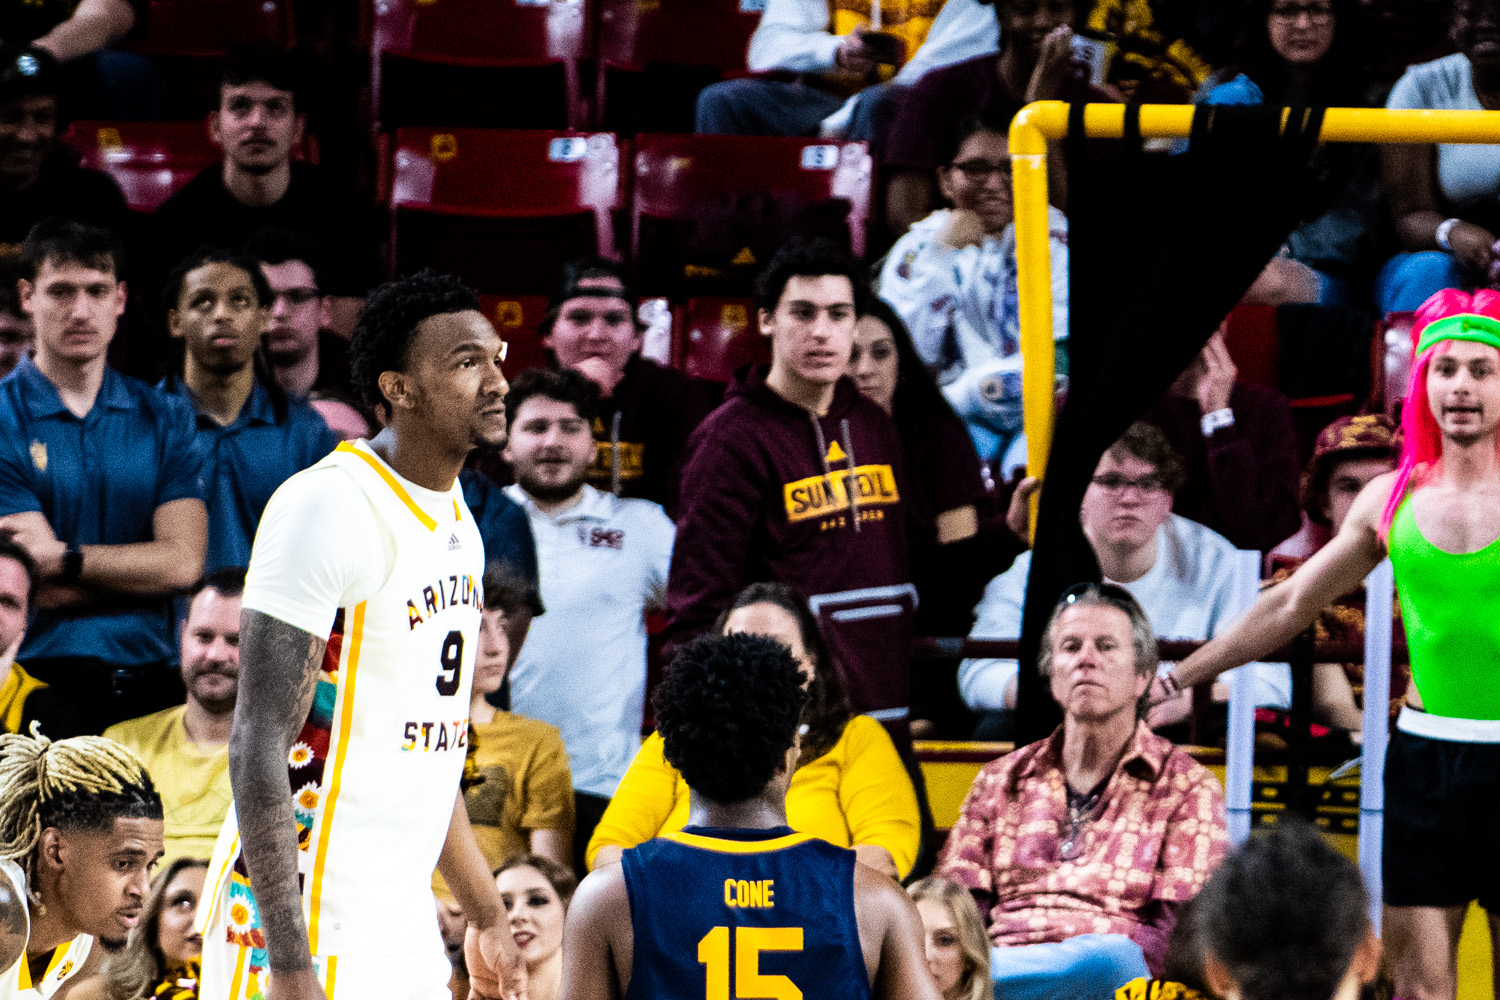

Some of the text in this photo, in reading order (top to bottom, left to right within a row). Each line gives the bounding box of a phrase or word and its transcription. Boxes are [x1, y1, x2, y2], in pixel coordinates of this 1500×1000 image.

[406, 573, 484, 631] ARIZON
[435, 630, 465, 697] 9
[724, 878, 775, 908] CONE
